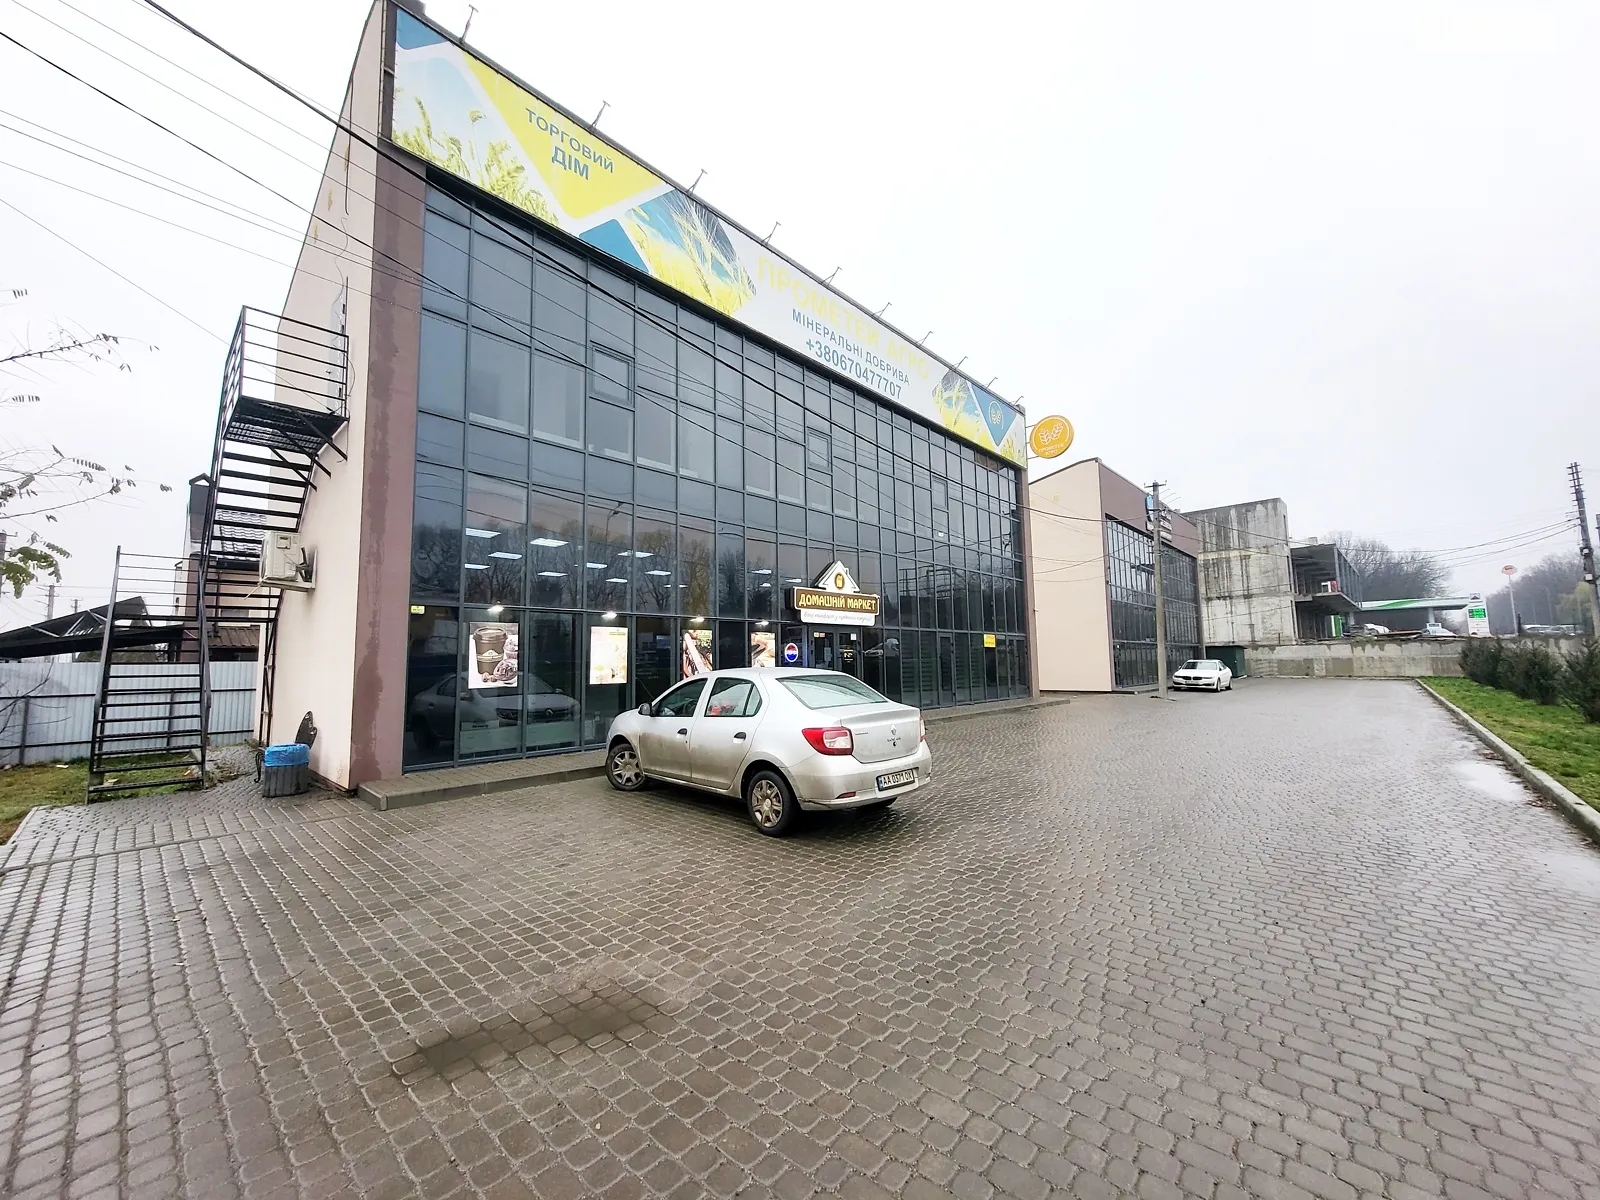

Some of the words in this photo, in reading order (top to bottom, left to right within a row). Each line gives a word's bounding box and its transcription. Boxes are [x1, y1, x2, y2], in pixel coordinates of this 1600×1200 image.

[525, 107, 614, 173] ТОРГОВИЙ
[551, 145, 589, 180] ДІМ
[757, 255, 880, 351] ПРОМЕТЕЙ
[886, 338, 930, 381] АГРО
[792, 308, 863, 359] МІНЕРАЛЬНІ
[865, 351, 910, 386] ДОБРИВА
[805, 338, 902, 399] +380670477707
[798, 593, 846, 608] ДОМАШНІЙ
[847, 598, 877, 611] МАРКЕТ
